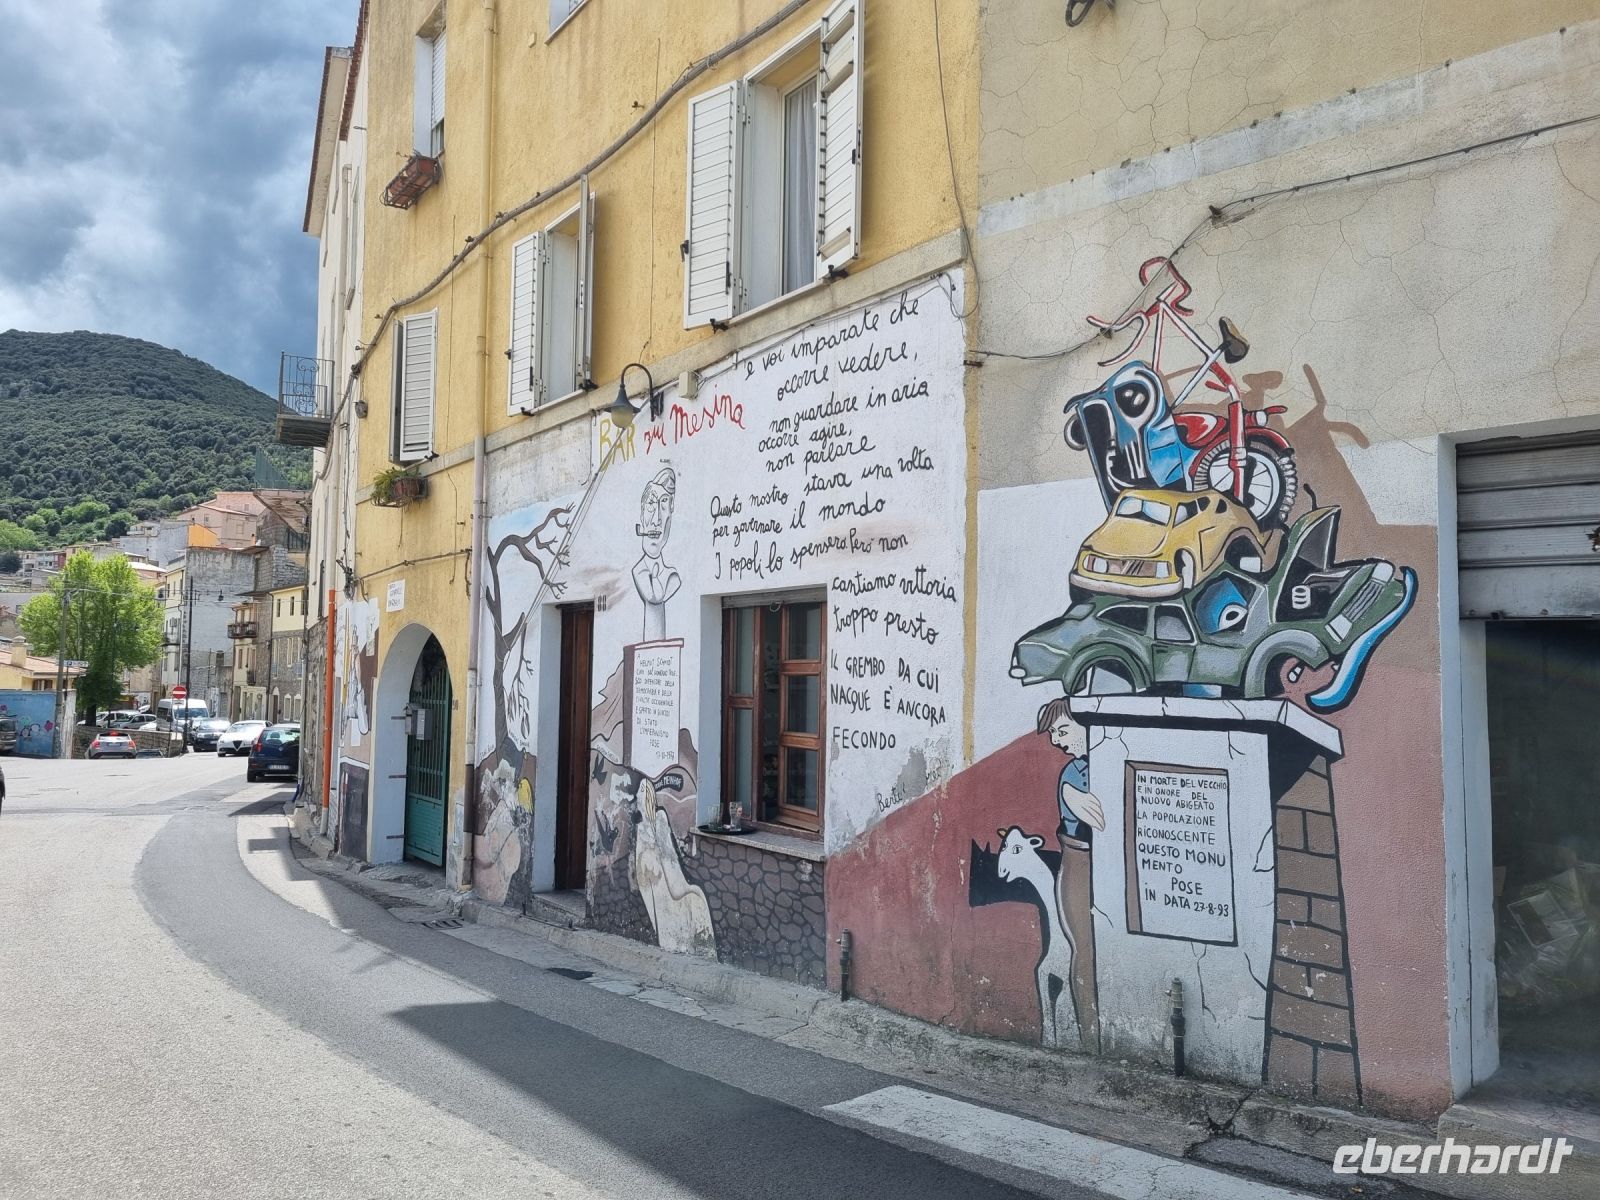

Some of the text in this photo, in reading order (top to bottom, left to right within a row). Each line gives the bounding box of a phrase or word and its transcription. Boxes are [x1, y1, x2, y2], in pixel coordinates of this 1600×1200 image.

[762, 350, 785, 371] voi
[791, 308, 880, 364] imparate
[890, 291, 919, 325] che
[777, 342, 918, 401] occorre vedere,
[769, 376, 929, 433] non guardare in aria
[599, 418, 635, 472] BAR
[669, 383, 746, 444] Mesina
[759, 422, 852, 453] occorre agire,
[766, 435, 876, 476] non parlare
[710, 446, 934, 526] Questo mostro stava una volta
[712, 491, 886, 547] per governare il mondo
[729, 540, 764, 580] popoli
[765, 541, 784, 573] lo
[878, 533, 909, 553] non
[832, 564, 957, 603] cantiamo vittoria
[833, 604, 939, 645] troppo presto
[830, 648, 939, 693] IL GREMBO DA CUI
[830, 684, 871, 714] NACQUE
[897, 698, 946, 727] ANCORA
[832, 726, 896, 750] FECONDO
[1137, 773, 1227, 791] IN MORTE DEL VECCHIO
[1137, 786, 1143, 794] E
[1155, 787, 1181, 798] ONORE
[1191, 791, 1208, 801] DEL
[1137, 810, 1216, 827] LA POPOLAZIONE
[1141, 795, 1215, 811] NUOVO ABIGEATO
[1137, 825, 1216, 845] RICONOSCENTE
[1138, 842, 1226, 867] QUESTO MONU
[1141, 858, 1183, 875] MENTO
[1144, 882, 1157, 902] IN
[1164, 893, 1191, 910] DATA
[1171, 877, 1203, 896] POSE
